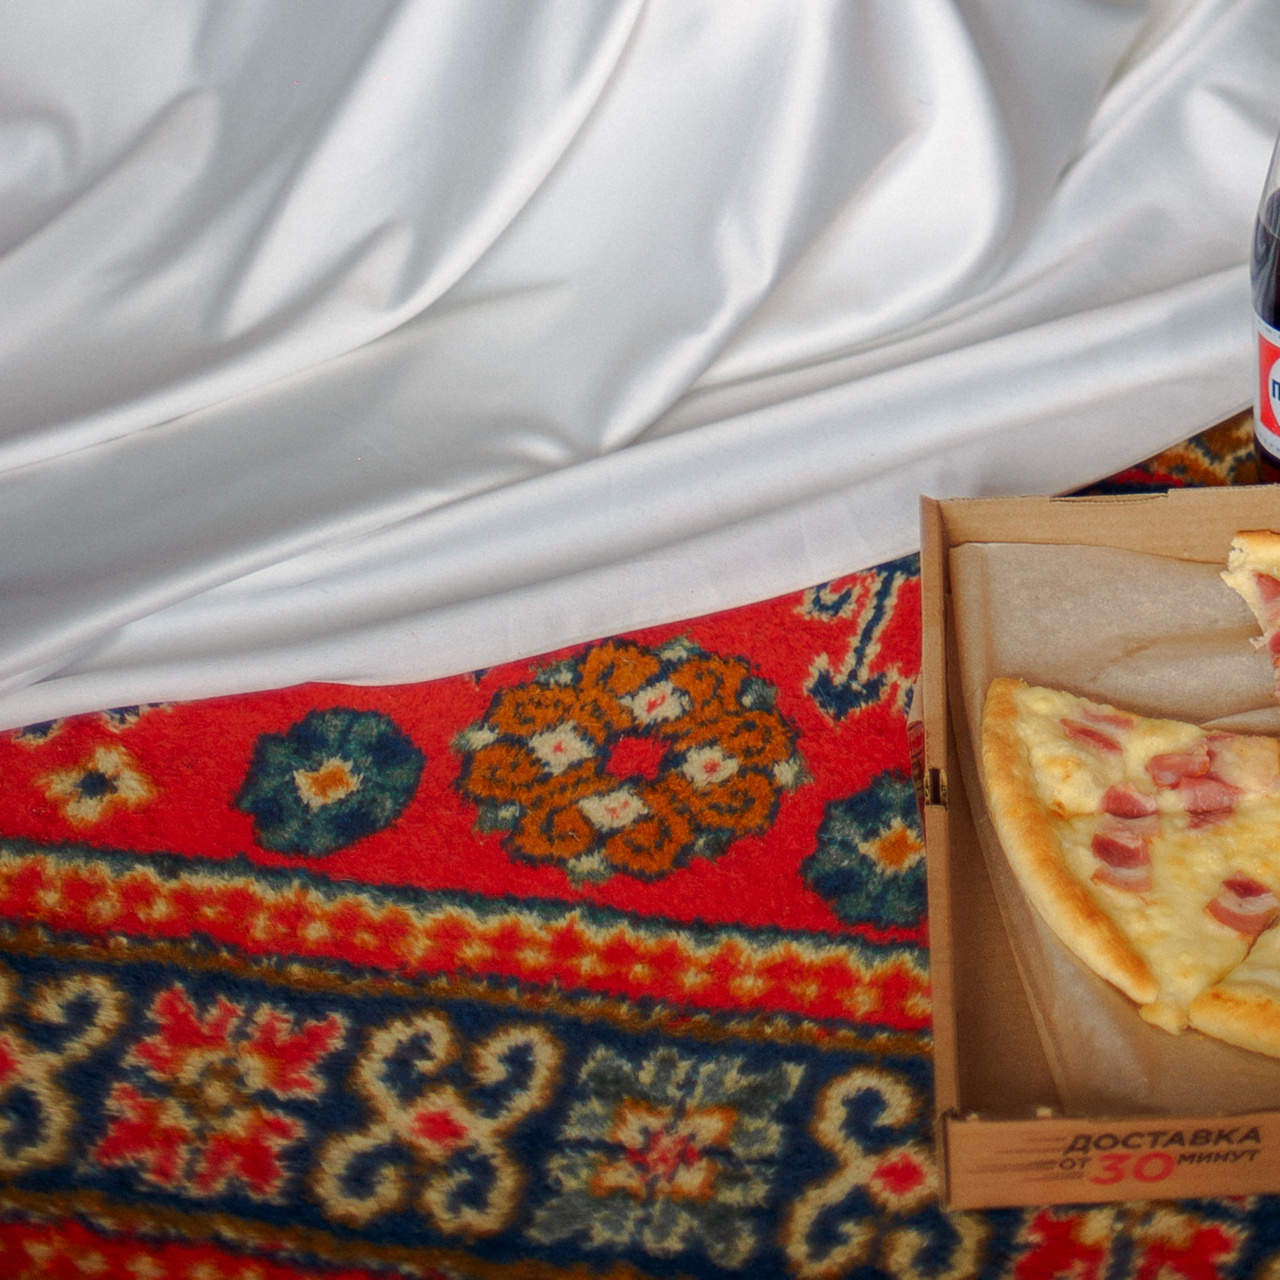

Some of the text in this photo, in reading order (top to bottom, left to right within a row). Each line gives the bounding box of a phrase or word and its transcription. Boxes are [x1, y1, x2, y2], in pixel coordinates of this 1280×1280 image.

[1063, 1126, 1261, 1155] ДОСТАВКА
[1059, 1148, 1261, 1185] ОТ 30 МИНУТ
